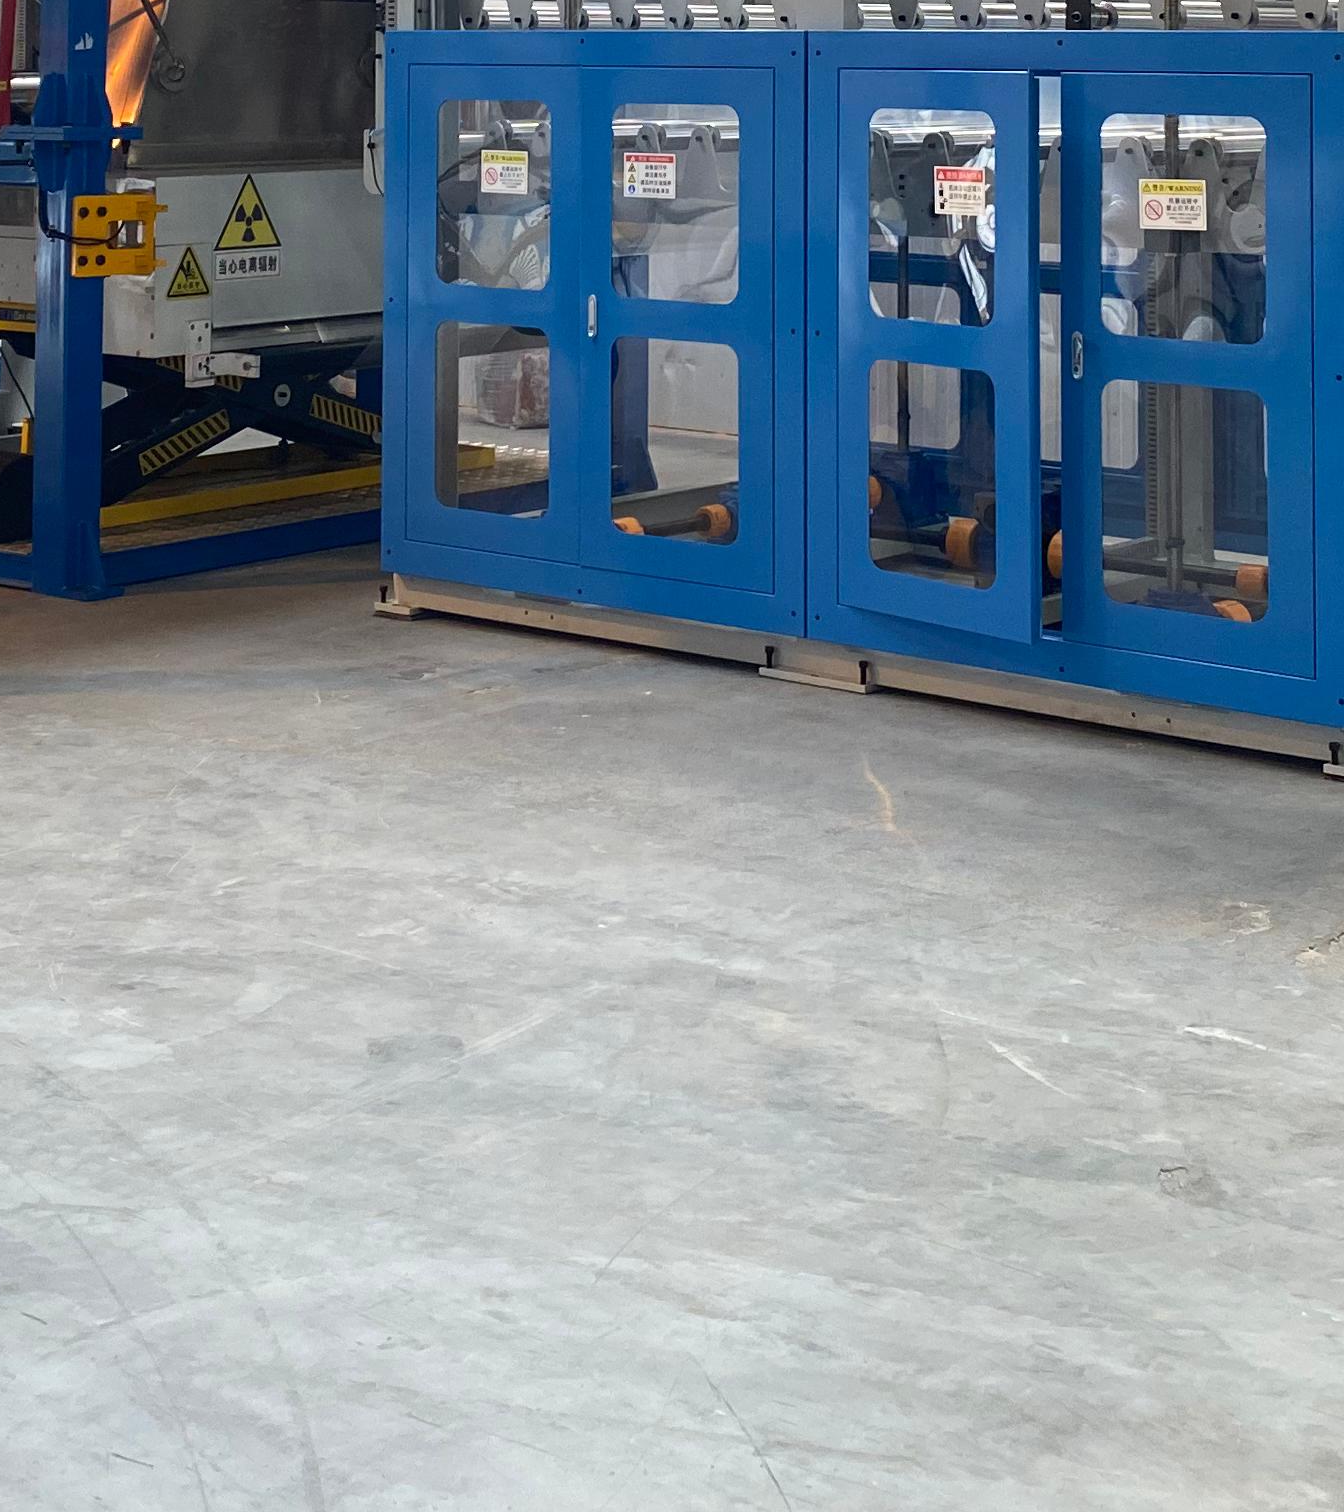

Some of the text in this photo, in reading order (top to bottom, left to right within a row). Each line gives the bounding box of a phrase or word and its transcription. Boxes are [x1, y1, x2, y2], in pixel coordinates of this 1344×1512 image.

[218, 255, 277, 275] 当心电离辐射
